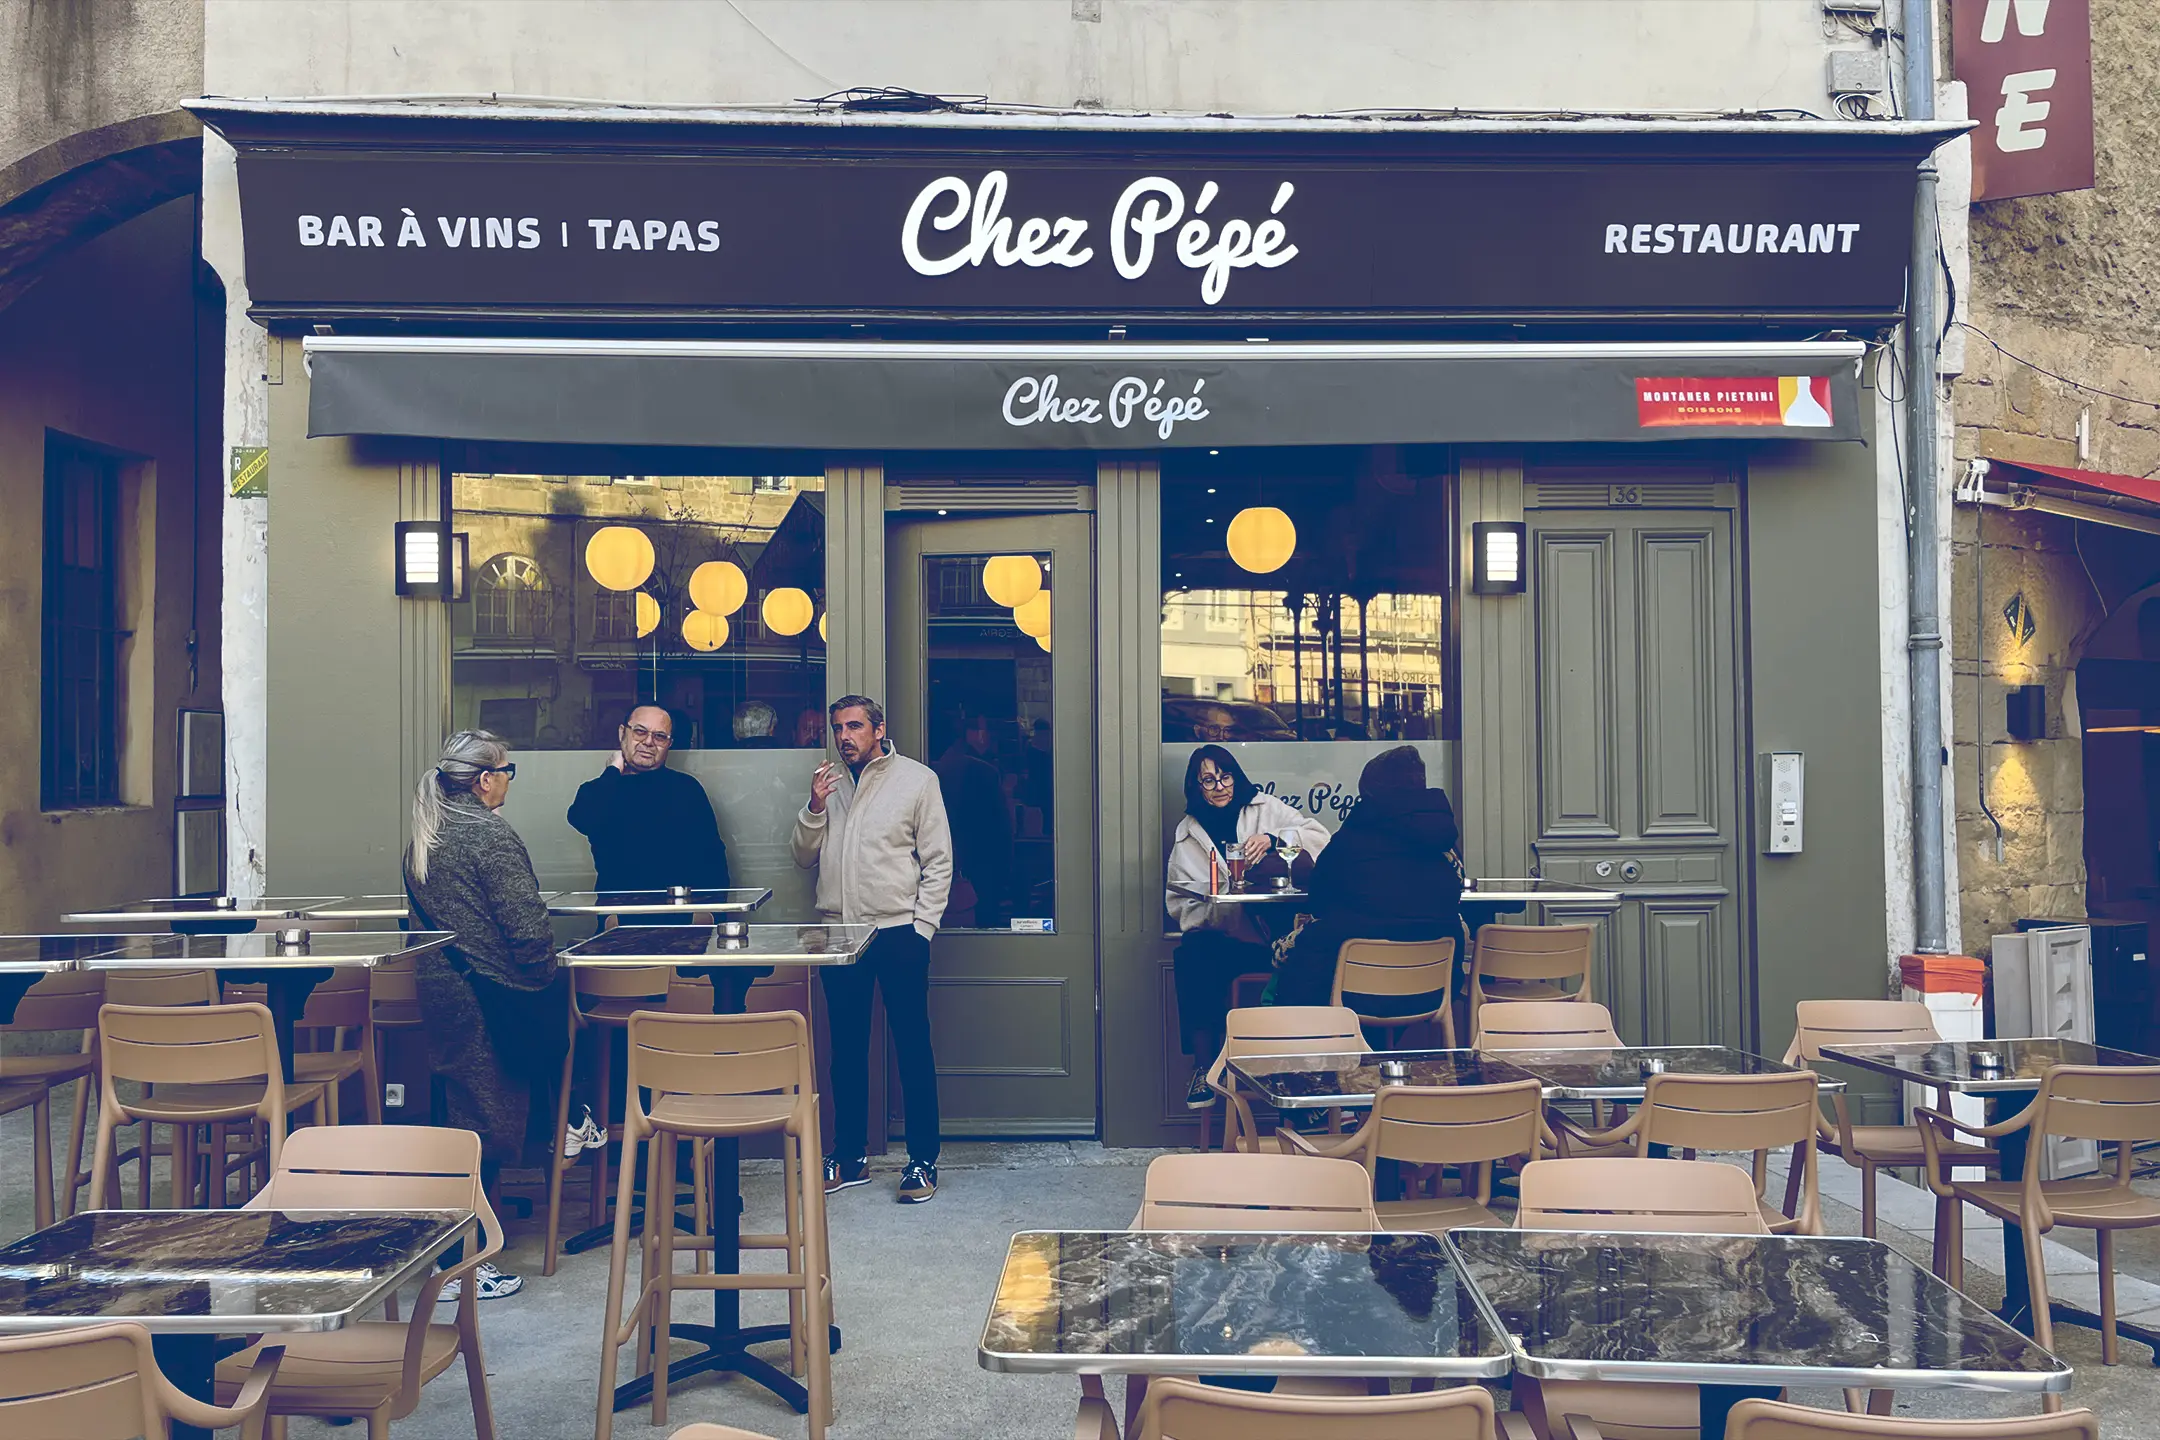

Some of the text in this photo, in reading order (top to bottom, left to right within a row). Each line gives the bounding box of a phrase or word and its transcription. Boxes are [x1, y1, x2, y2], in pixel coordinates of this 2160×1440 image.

[298, 215, 383, 247] BAR
[397, 207, 427, 247] À
[437, 216, 541, 249] VINS
[588, 219, 721, 252] TAPAS
[901, 170, 1299, 305] Chez Pépé
[1604, 223, 1860, 254] RESTAURANT
[1002, 374, 1210, 440] Chez Pépé
[1643, 391, 1774, 402] MONTANER PIETRINI
[1615, 486, 1638, 503] 36
